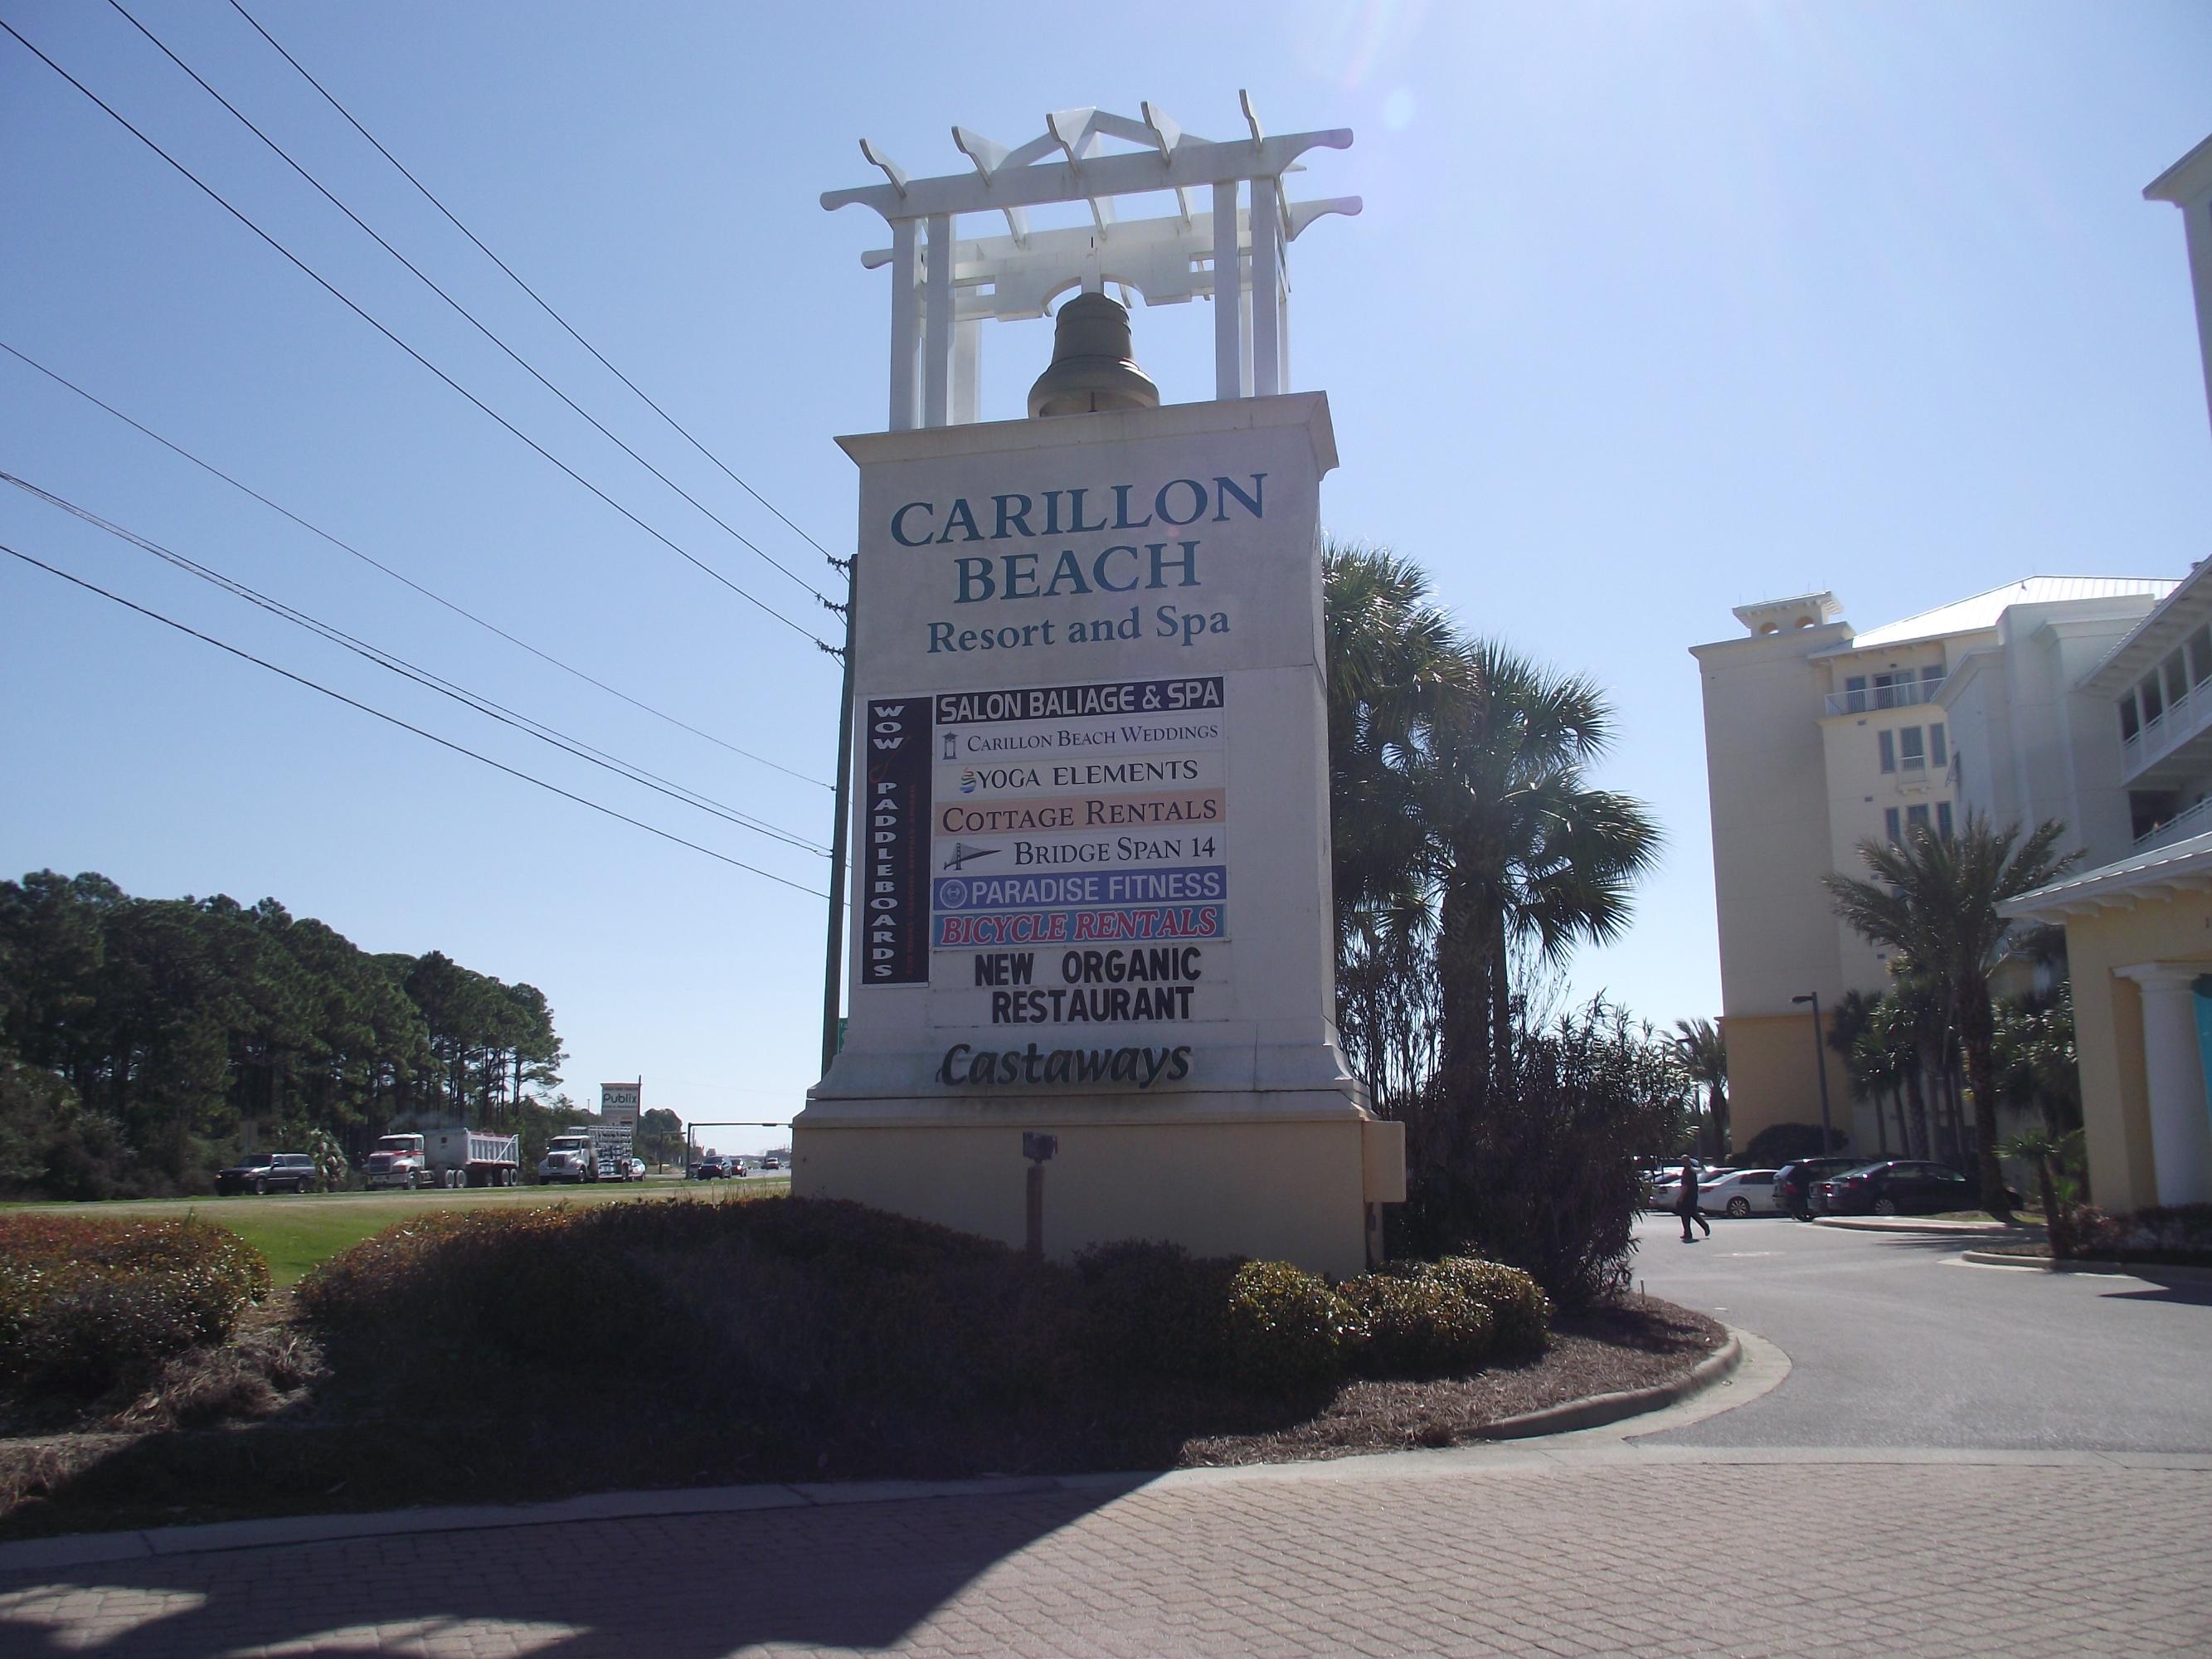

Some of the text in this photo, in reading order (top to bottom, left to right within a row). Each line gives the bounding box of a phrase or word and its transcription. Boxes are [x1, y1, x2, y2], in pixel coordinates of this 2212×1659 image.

[891, 473, 1268, 547] CARILLON
[954, 540, 1201, 604] BEACH
[927, 604, 1230, 653] Resort and Spa
[941, 681, 1219, 722] SALON BALIAGE & SPA
[873, 705, 905, 750] WOW
[967, 725, 1218, 752] CARILLON BEACH WEDDINGS
[975, 760, 1198, 790] YOGA ELEMENTS
[943, 799, 1217, 832] COTTAGE RENTALS
[1014, 836, 1215, 865] BRIDGE SPAN 14
[972, 872, 1221, 904] PARADISE FITNESS
[941, 907, 1218, 944] BICYCLE RENTALS
[975, 947, 1202, 986] NEW ORGANIC
[992, 985, 1194, 1024] RESTAURANT
[936, 1042, 1191, 1089] Castaways
[603, 1093, 637, 1103] Publix
